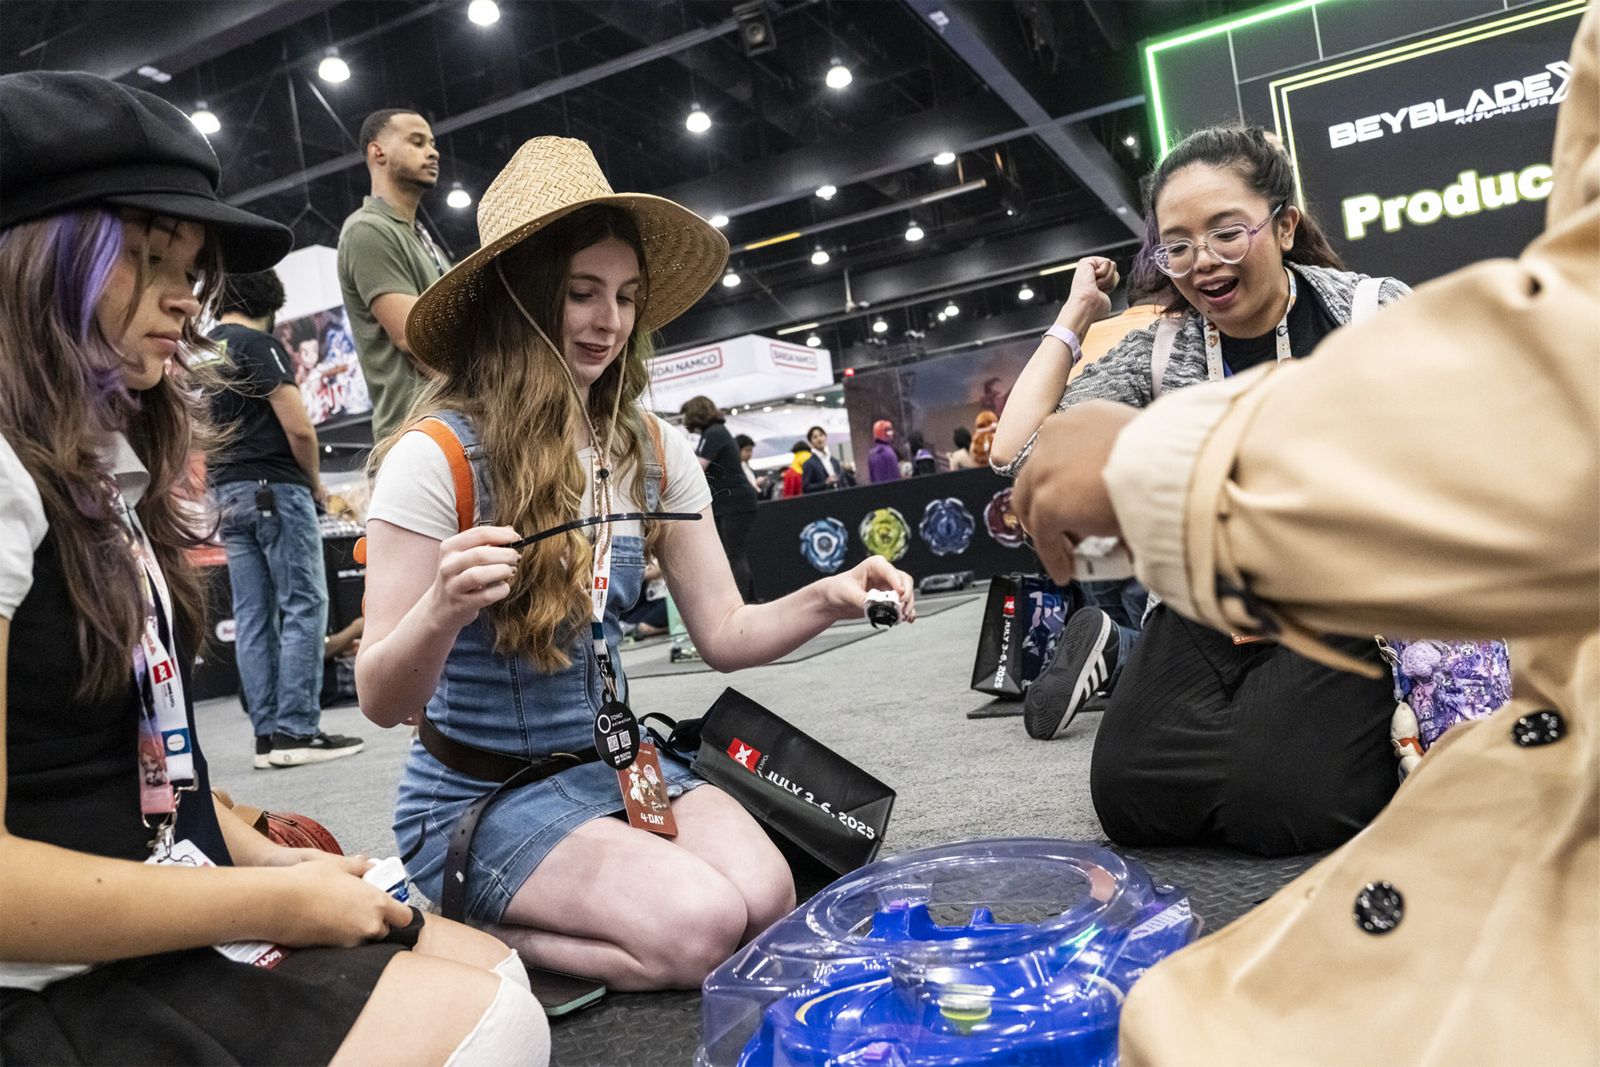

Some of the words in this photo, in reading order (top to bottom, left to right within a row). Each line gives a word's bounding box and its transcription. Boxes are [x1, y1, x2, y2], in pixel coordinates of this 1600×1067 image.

[676, 354, 717, 372] NAMCO
[1003, 620, 1011, 642] JULY
[994, 665, 1006, 688] 2025
[764, 770, 803, 796] JULY
[838, 812, 876, 840] 2025
[640, 812, 665, 826] 4-DAY
